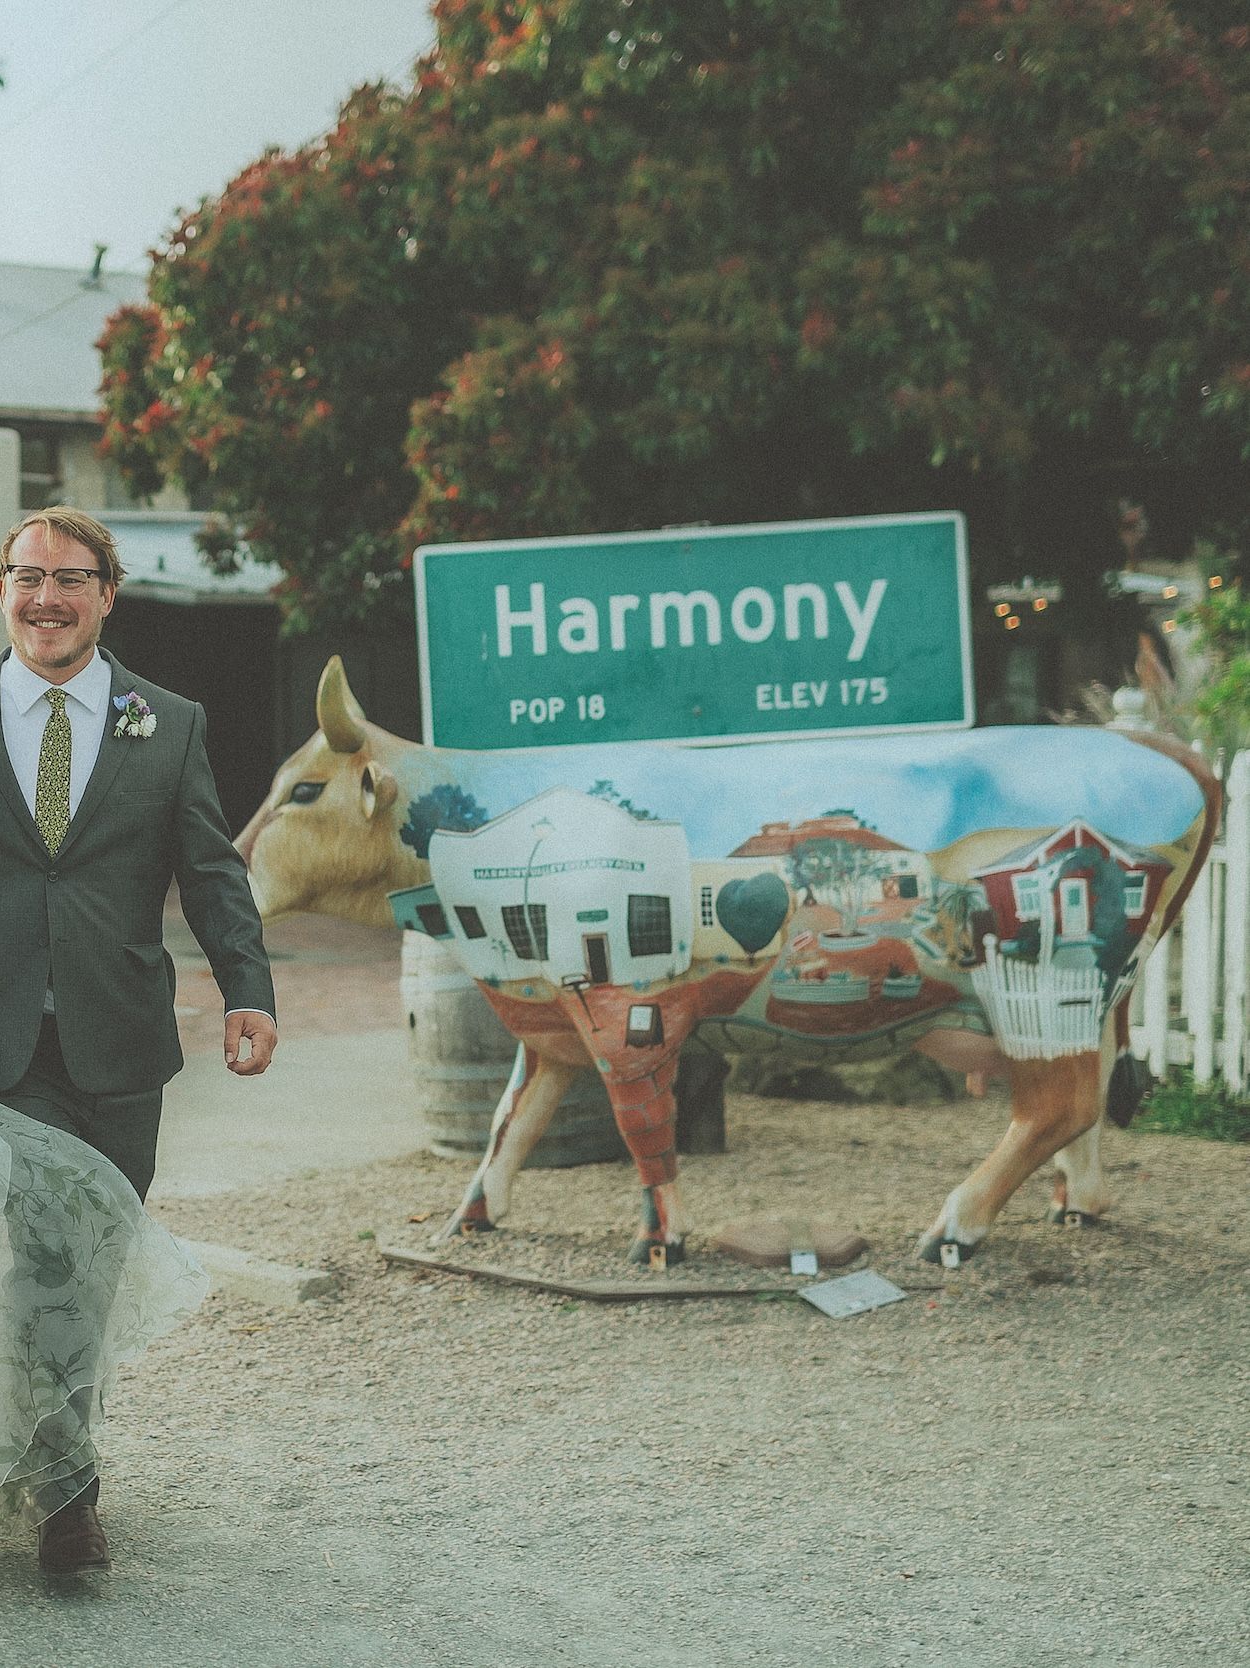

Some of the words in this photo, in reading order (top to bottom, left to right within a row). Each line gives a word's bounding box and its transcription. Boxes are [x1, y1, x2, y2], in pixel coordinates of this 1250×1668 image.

[494, 578, 888, 662] Harmony
[510, 697, 565, 724] POP
[577, 694, 607, 721] 18
[755, 680, 829, 711] ELEV
[839, 677, 889, 706] 175
